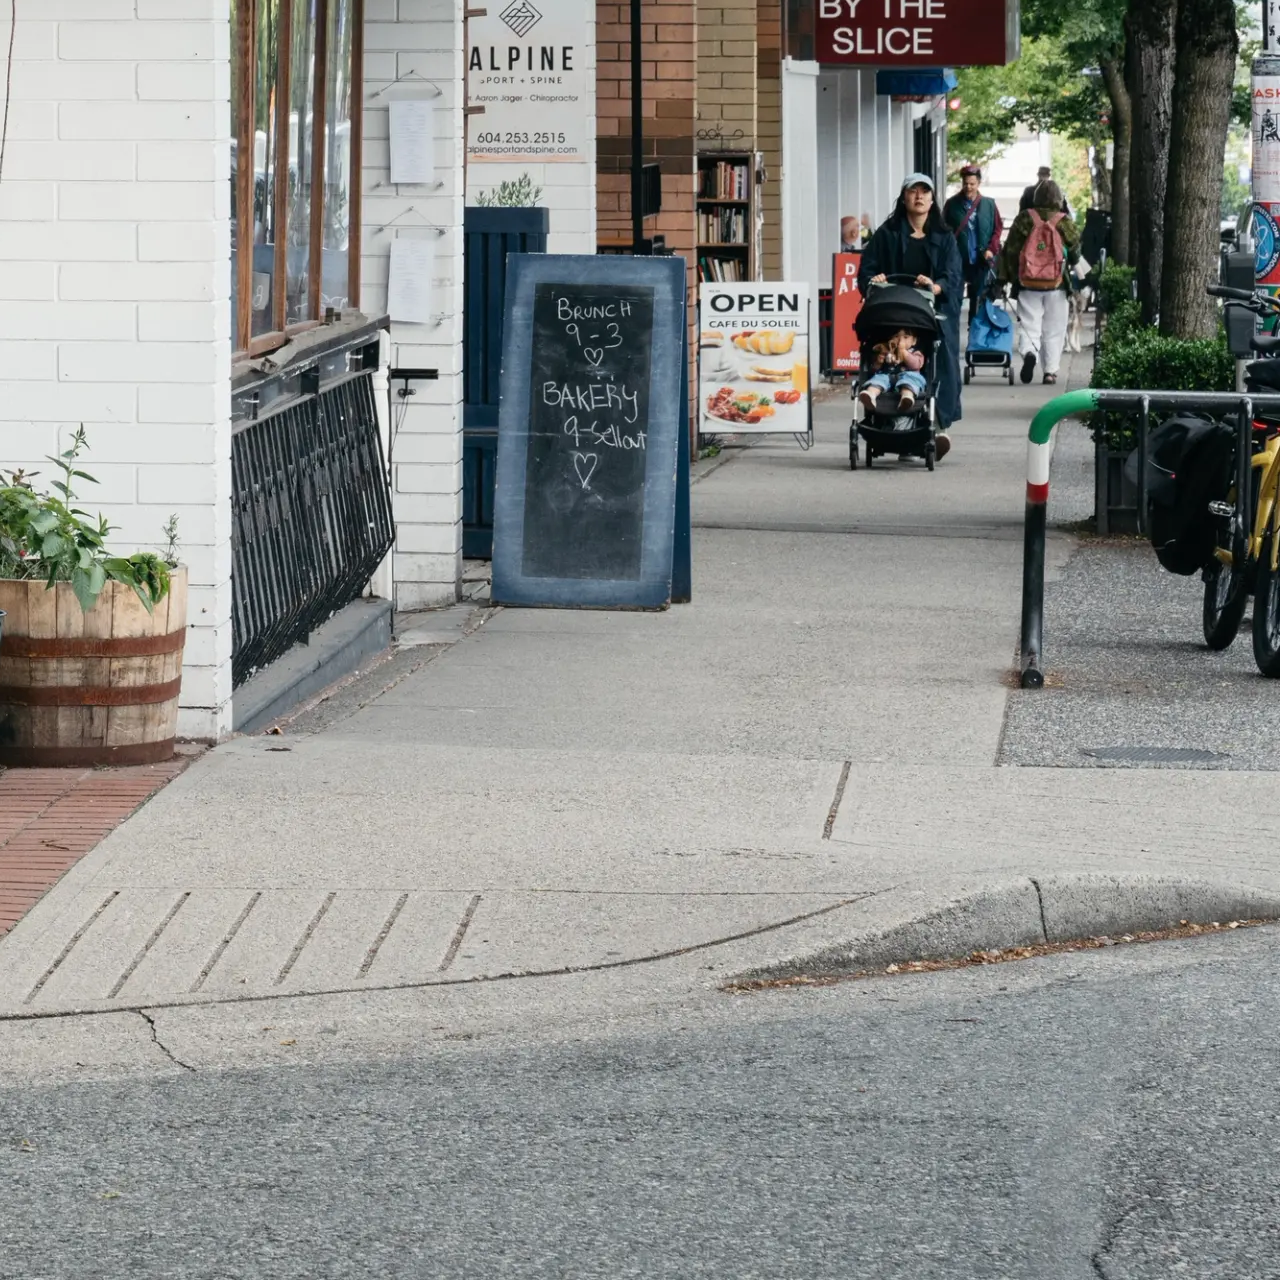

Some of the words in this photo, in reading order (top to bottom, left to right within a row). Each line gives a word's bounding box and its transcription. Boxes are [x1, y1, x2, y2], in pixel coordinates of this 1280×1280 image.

[832, 27, 934, 55] SLICE
[469, 46, 573, 71] ALPINE
[480, 76, 515, 85] SPORT
[530, 76, 563, 85] SPINE
[475, 94, 499, 102] Aaron
[500, 94, 523, 103] Jager
[529, 94, 579, 103] Chiropractor
[477, 132, 566, 144] 604.253.2515
[467, 145, 578, 155] alpinesportandspine.com
[710, 293, 798, 312] OPEN
[557, 297, 632, 321] BRUNCH
[708, 320, 738, 328] CAFE
[741, 320, 759, 328] DU
[761, 320, 801, 328] SOLEIL
